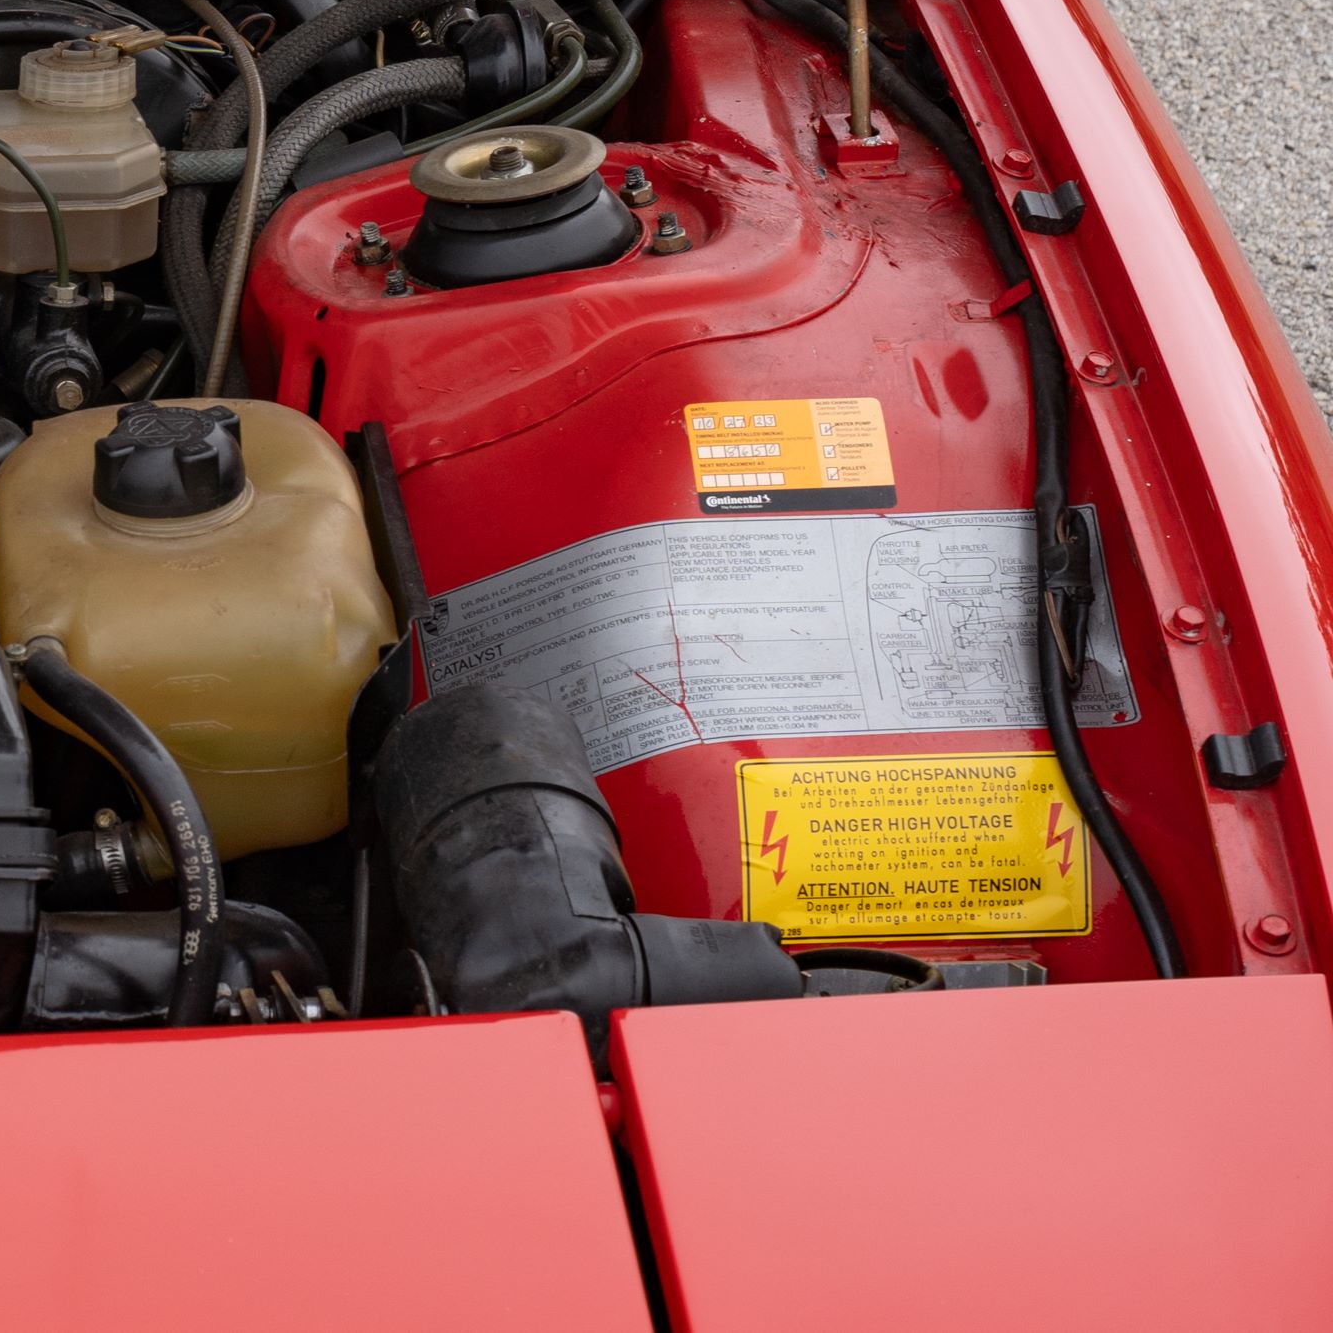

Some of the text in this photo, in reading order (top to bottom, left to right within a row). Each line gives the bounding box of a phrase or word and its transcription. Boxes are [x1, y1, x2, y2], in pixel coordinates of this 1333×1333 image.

[706, 495, 762, 507] Continental
[887, 519, 926, 527] VACUUM
[927, 518, 952, 526] HOSE
[953, 516, 995, 524] ROUTING
[690, 535, 727, 543] VEHICLE
[729, 533, 780, 541] CONFORMS
[619, 539, 663, 552] GERMANY
[690, 542, 751, 550] REGULATIONS
[670, 551, 723, 559] APPLICABLE
[880, 556, 920, 564] HOUSING
[693, 558, 726, 566] MOTOR
[672, 565, 804, 575] COMPLIANCE DEMONSTRATED
[673, 575, 705, 583] BELOW
[730, 573, 752, 581] FEET
[710, 607, 759, 615] OPERATING
[762, 606, 827, 614] TEMPERATURE
[432, 643, 505, 683] CATALYST
[738, 703, 852, 713] ADDITIONAL INFORMATION
[792, 766, 1017, 784] ACHTUNG HOCHSPANNUNG
[773, 787, 792, 798] Bei
[803, 787, 857, 796] Arbeiten
[889, 786, 908, 794] der
[916, 785, 974, 796] gesamten
[982, 780, 1054, 793] Zündanlage
[801, 794, 1024, 809] und Drehzahlmesser Lebensgefahr.
[810, 815, 1013, 833] DANGER HIGH VOLTAGE
[822, 831, 1005, 846] electric shock suffered when
[814, 848, 864, 860] working
[896, 845, 945, 859] ignition
[956, 845, 978, 856] and
[811, 862, 880, 872] tachometer
[941, 860, 962, 868] can
[970, 857, 983, 868] be
[990, 856, 1026, 867] fatal.
[797, 877, 1041, 897] ATTENTION. HAUTE TENSION
[188, 887, 202, 911] 931
[807, 897, 1024, 914] Danger de mort en cas de travaux
[809, 917, 828, 925] sur
[849, 912, 908, 925] allumage
